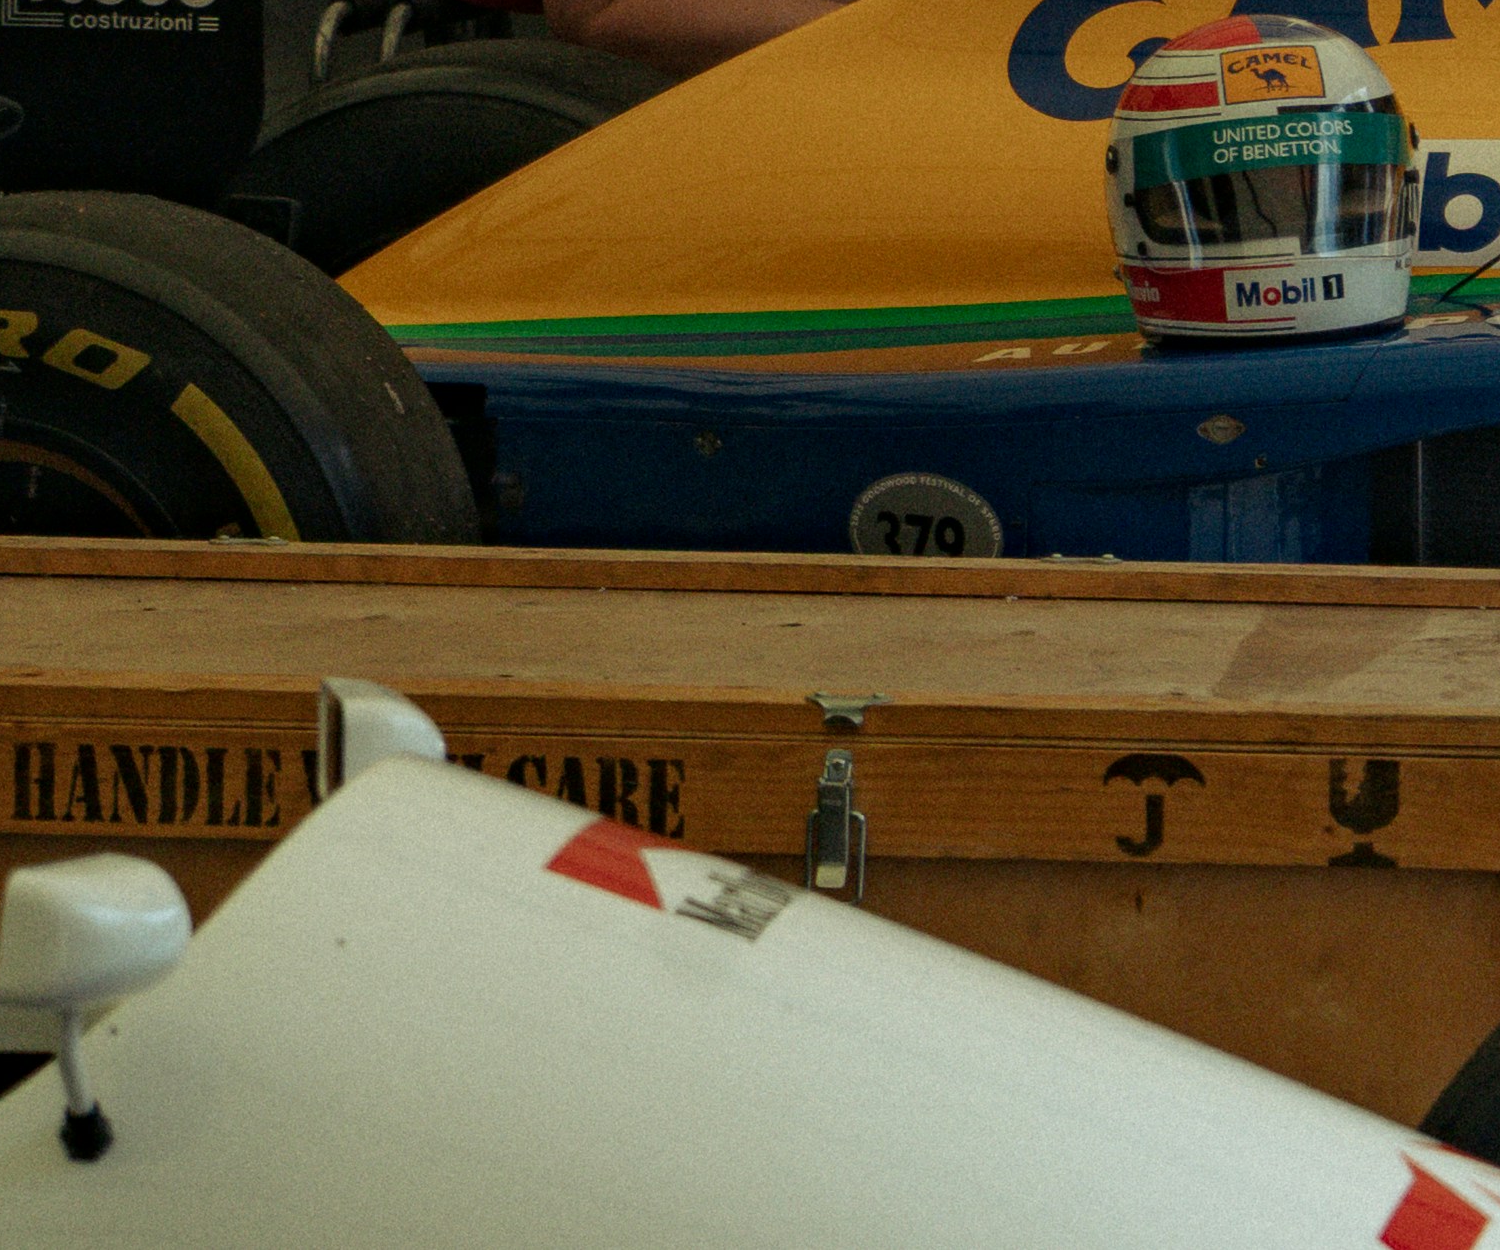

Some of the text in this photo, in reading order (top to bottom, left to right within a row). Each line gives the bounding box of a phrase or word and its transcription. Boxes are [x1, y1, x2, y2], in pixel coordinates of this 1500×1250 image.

[68, 11, 194, 32] costruzioni
[1226, 52, 1313, 74] CAMEL
[1212, 119, 1354, 146] UNITED COLORS
[1212, 147, 1241, 165] OF
[1234, 273, 1346, 308] Mobil 1
[10, 740, 284, 829] HANDLE
